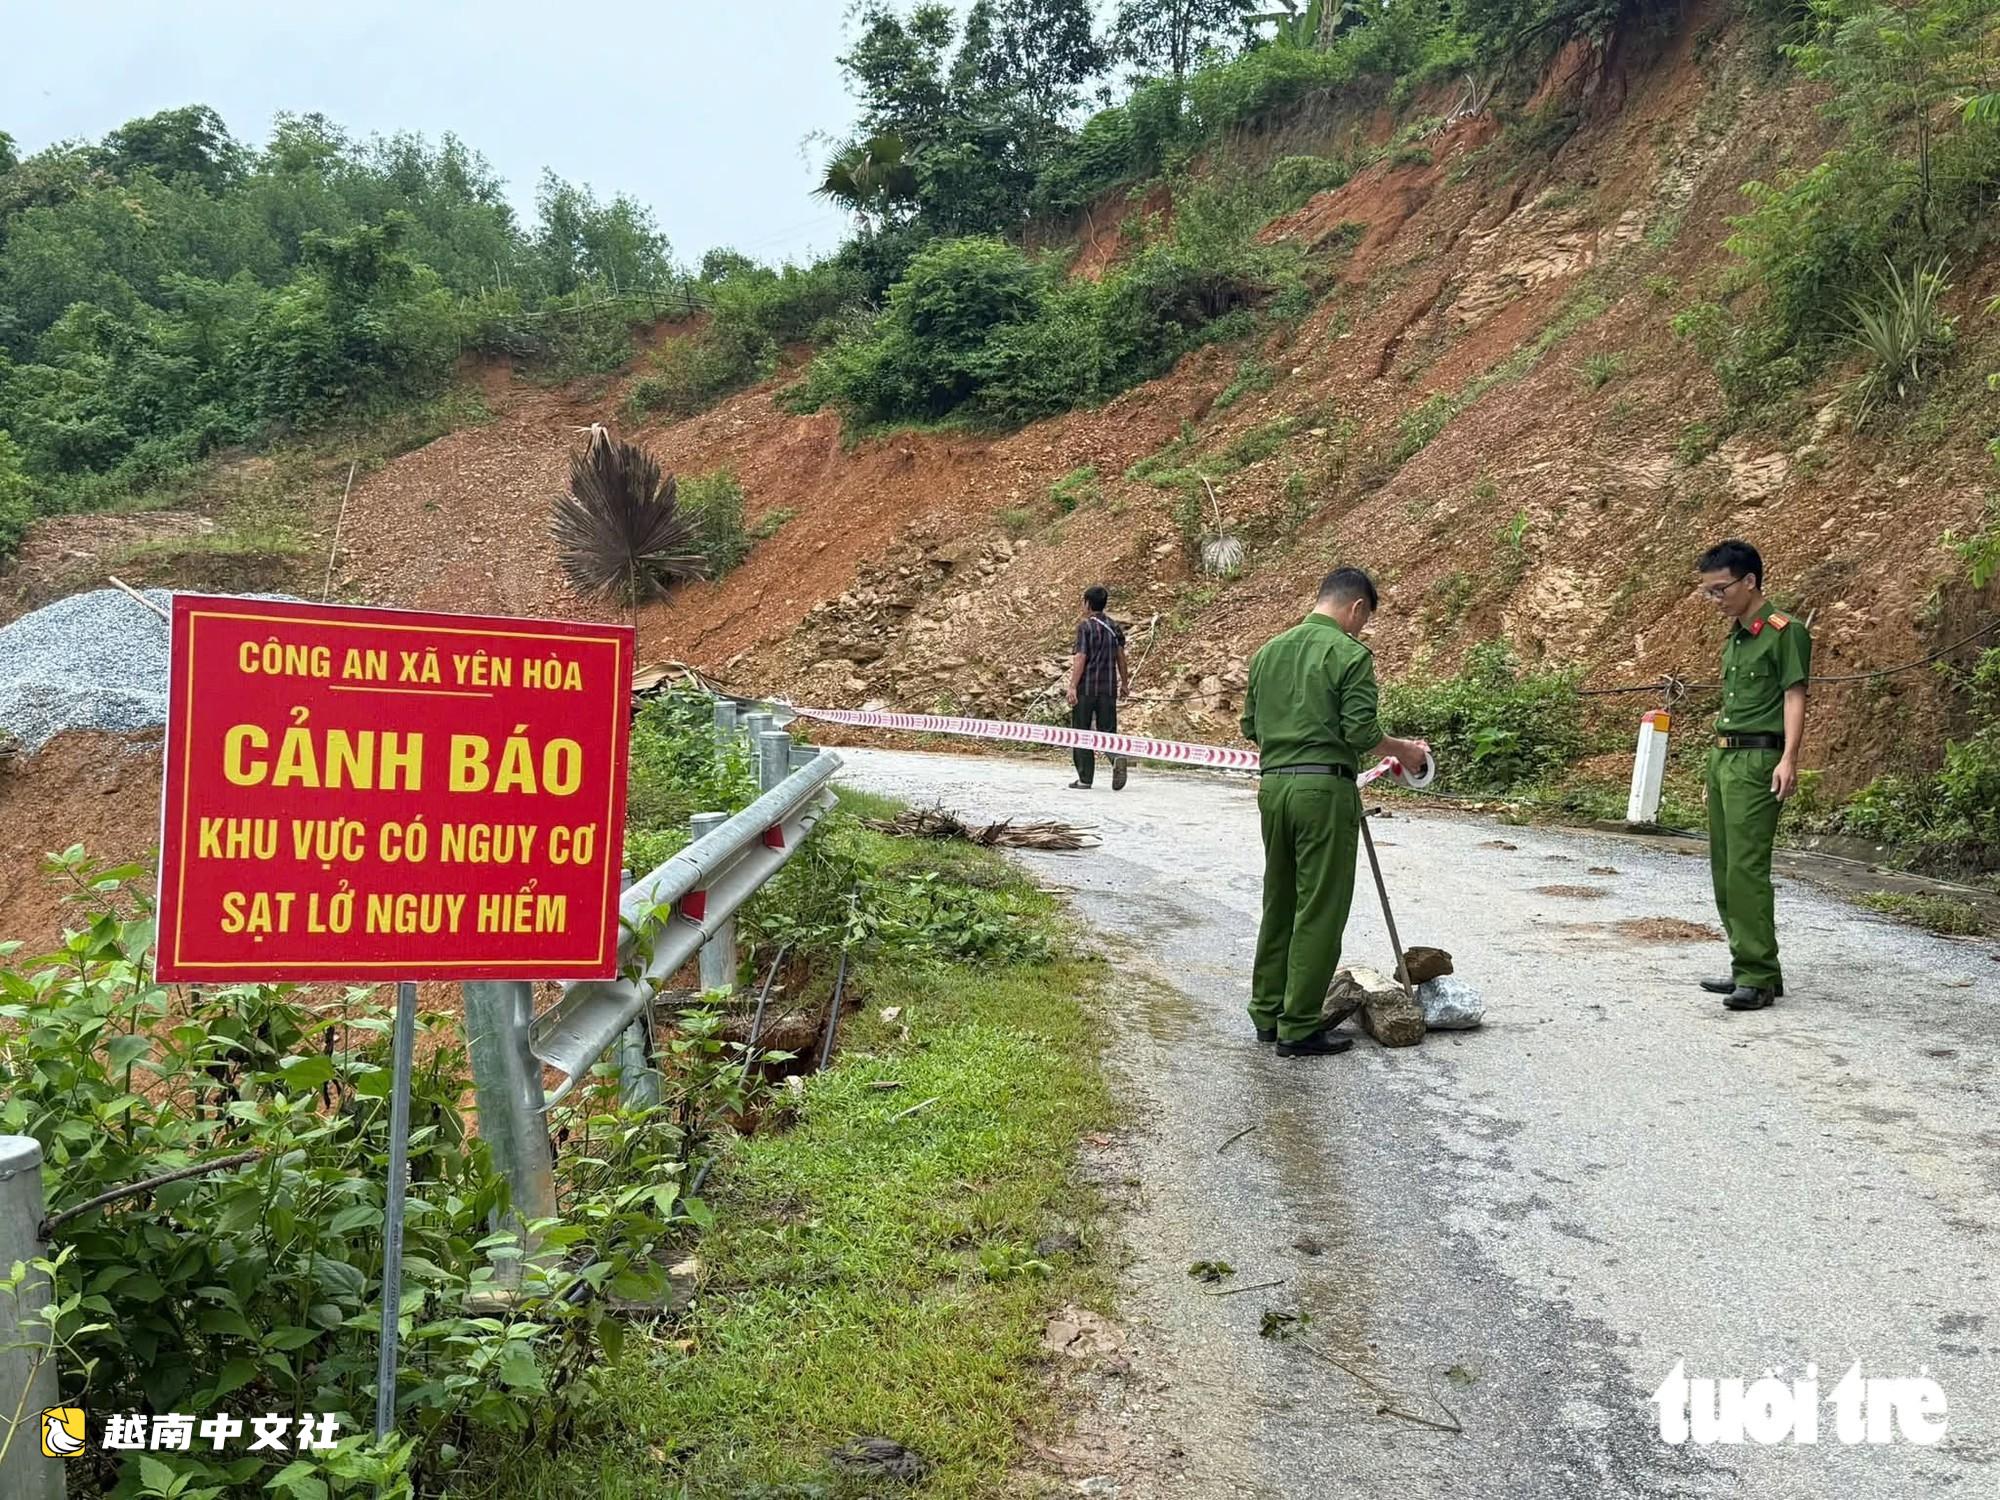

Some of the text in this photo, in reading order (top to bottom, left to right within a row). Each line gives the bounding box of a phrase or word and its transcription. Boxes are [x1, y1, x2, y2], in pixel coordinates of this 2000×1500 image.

[239, 636, 583, 691] CÔNG AN XÃ YÊN HÒA
[223, 706, 583, 796] CẢNH BÁO
[199, 814, 597, 870] KHU VỰC CÓ NGUY CƠ
[221, 878, 567, 942] SẠT LỞ NGUY HIỂM
